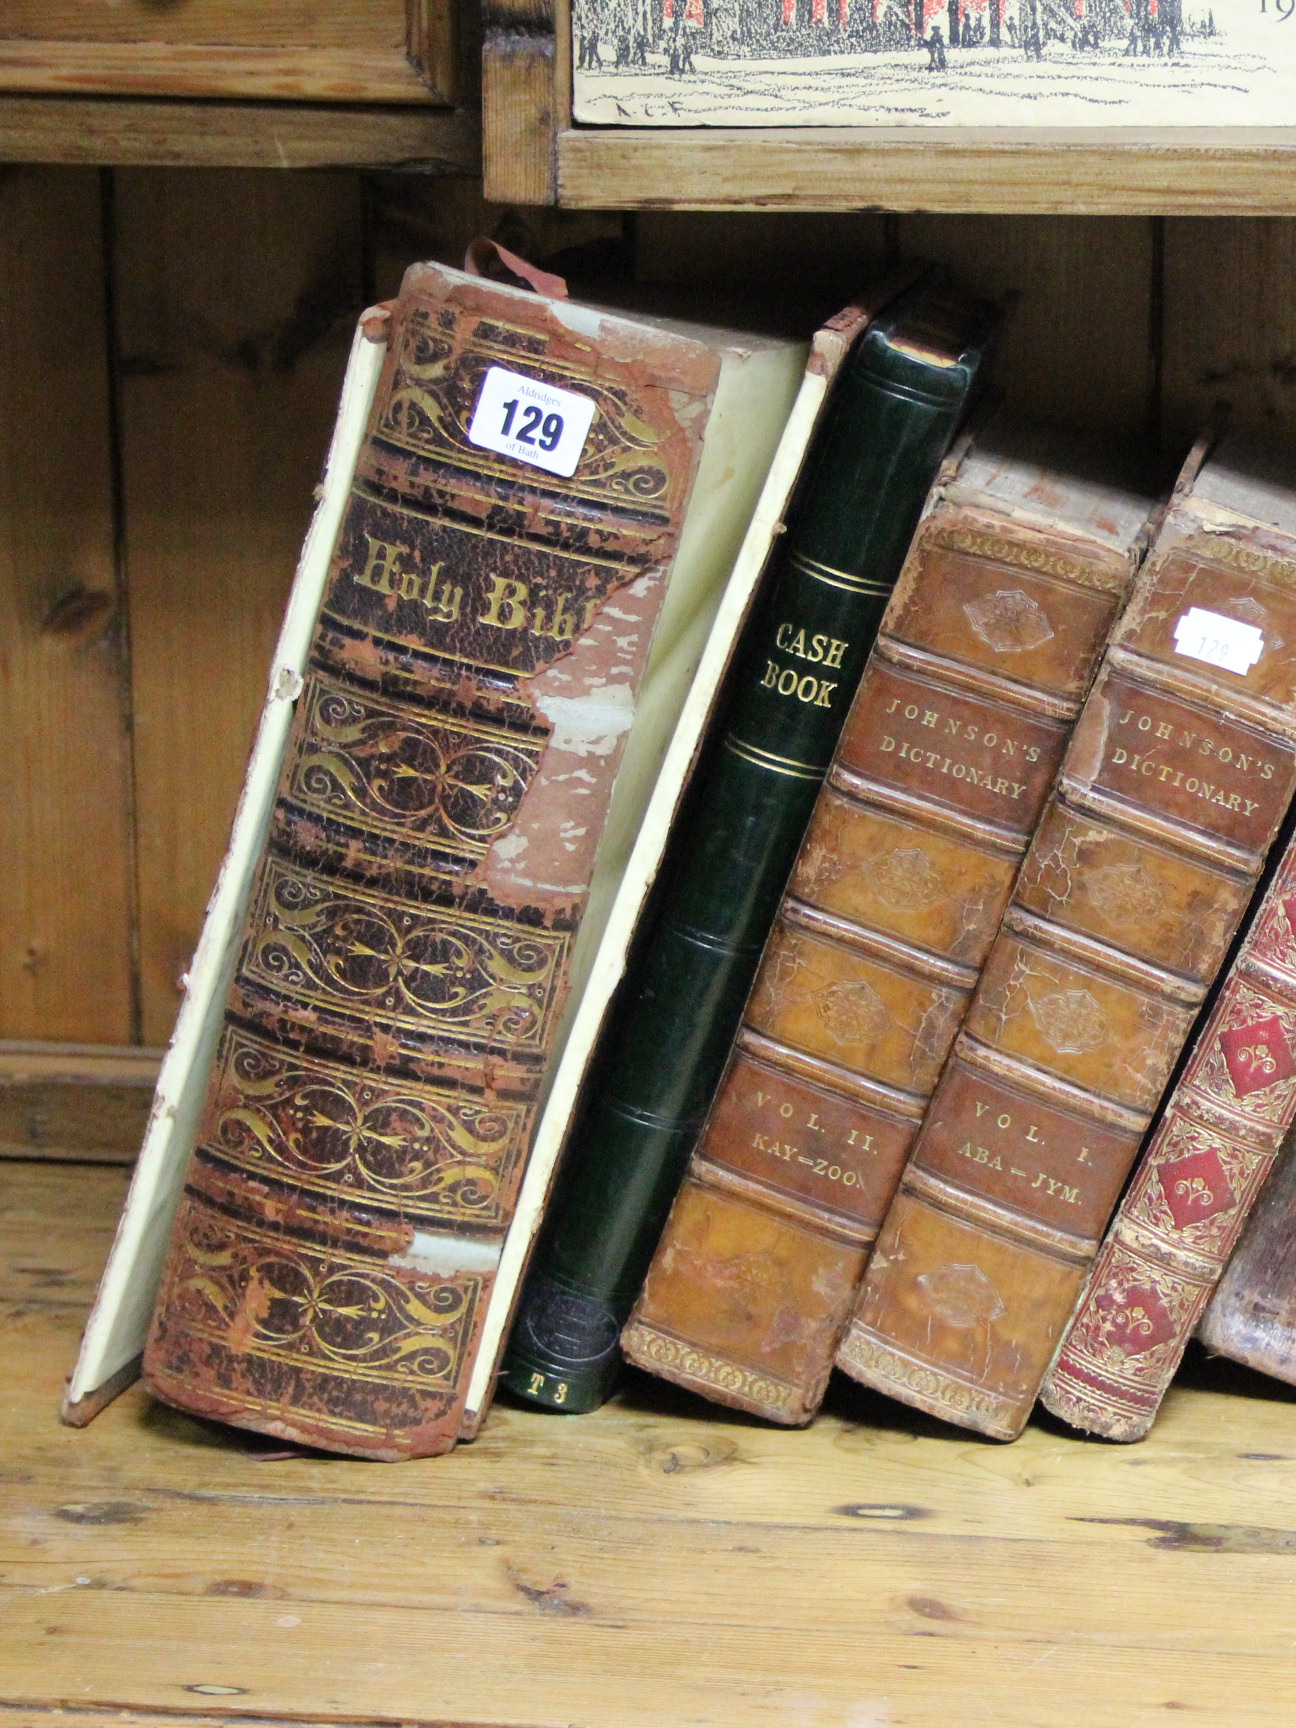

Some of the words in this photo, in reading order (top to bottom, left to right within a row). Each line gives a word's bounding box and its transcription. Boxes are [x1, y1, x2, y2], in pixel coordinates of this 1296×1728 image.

[500, 398, 564, 452] 129
[516, 385, 562, 408] Aldridges
[505, 441, 517, 452] of
[518, 443, 540, 460] Bath
[354, 533, 464, 622] Holy
[776, 623, 849, 669] CASH
[1198, 636, 1230, 662] 129
[760, 659, 838, 708] BOOK
[886, 698, 1041, 762] JOHNSON'S
[1119, 709, 1275, 780] JOHNSON'S
[880, 735, 1027, 799] DICTIONARY
[1111, 747, 1260, 816] DICTIONARY
[757, 1091, 825, 1134] VOL.
[847, 1129, 878, 1155] II.
[976, 1101, 1046, 1146] VOL.
[1077, 1147, 1093, 1167] I.
[553, 1382, 568, 1403] 3
